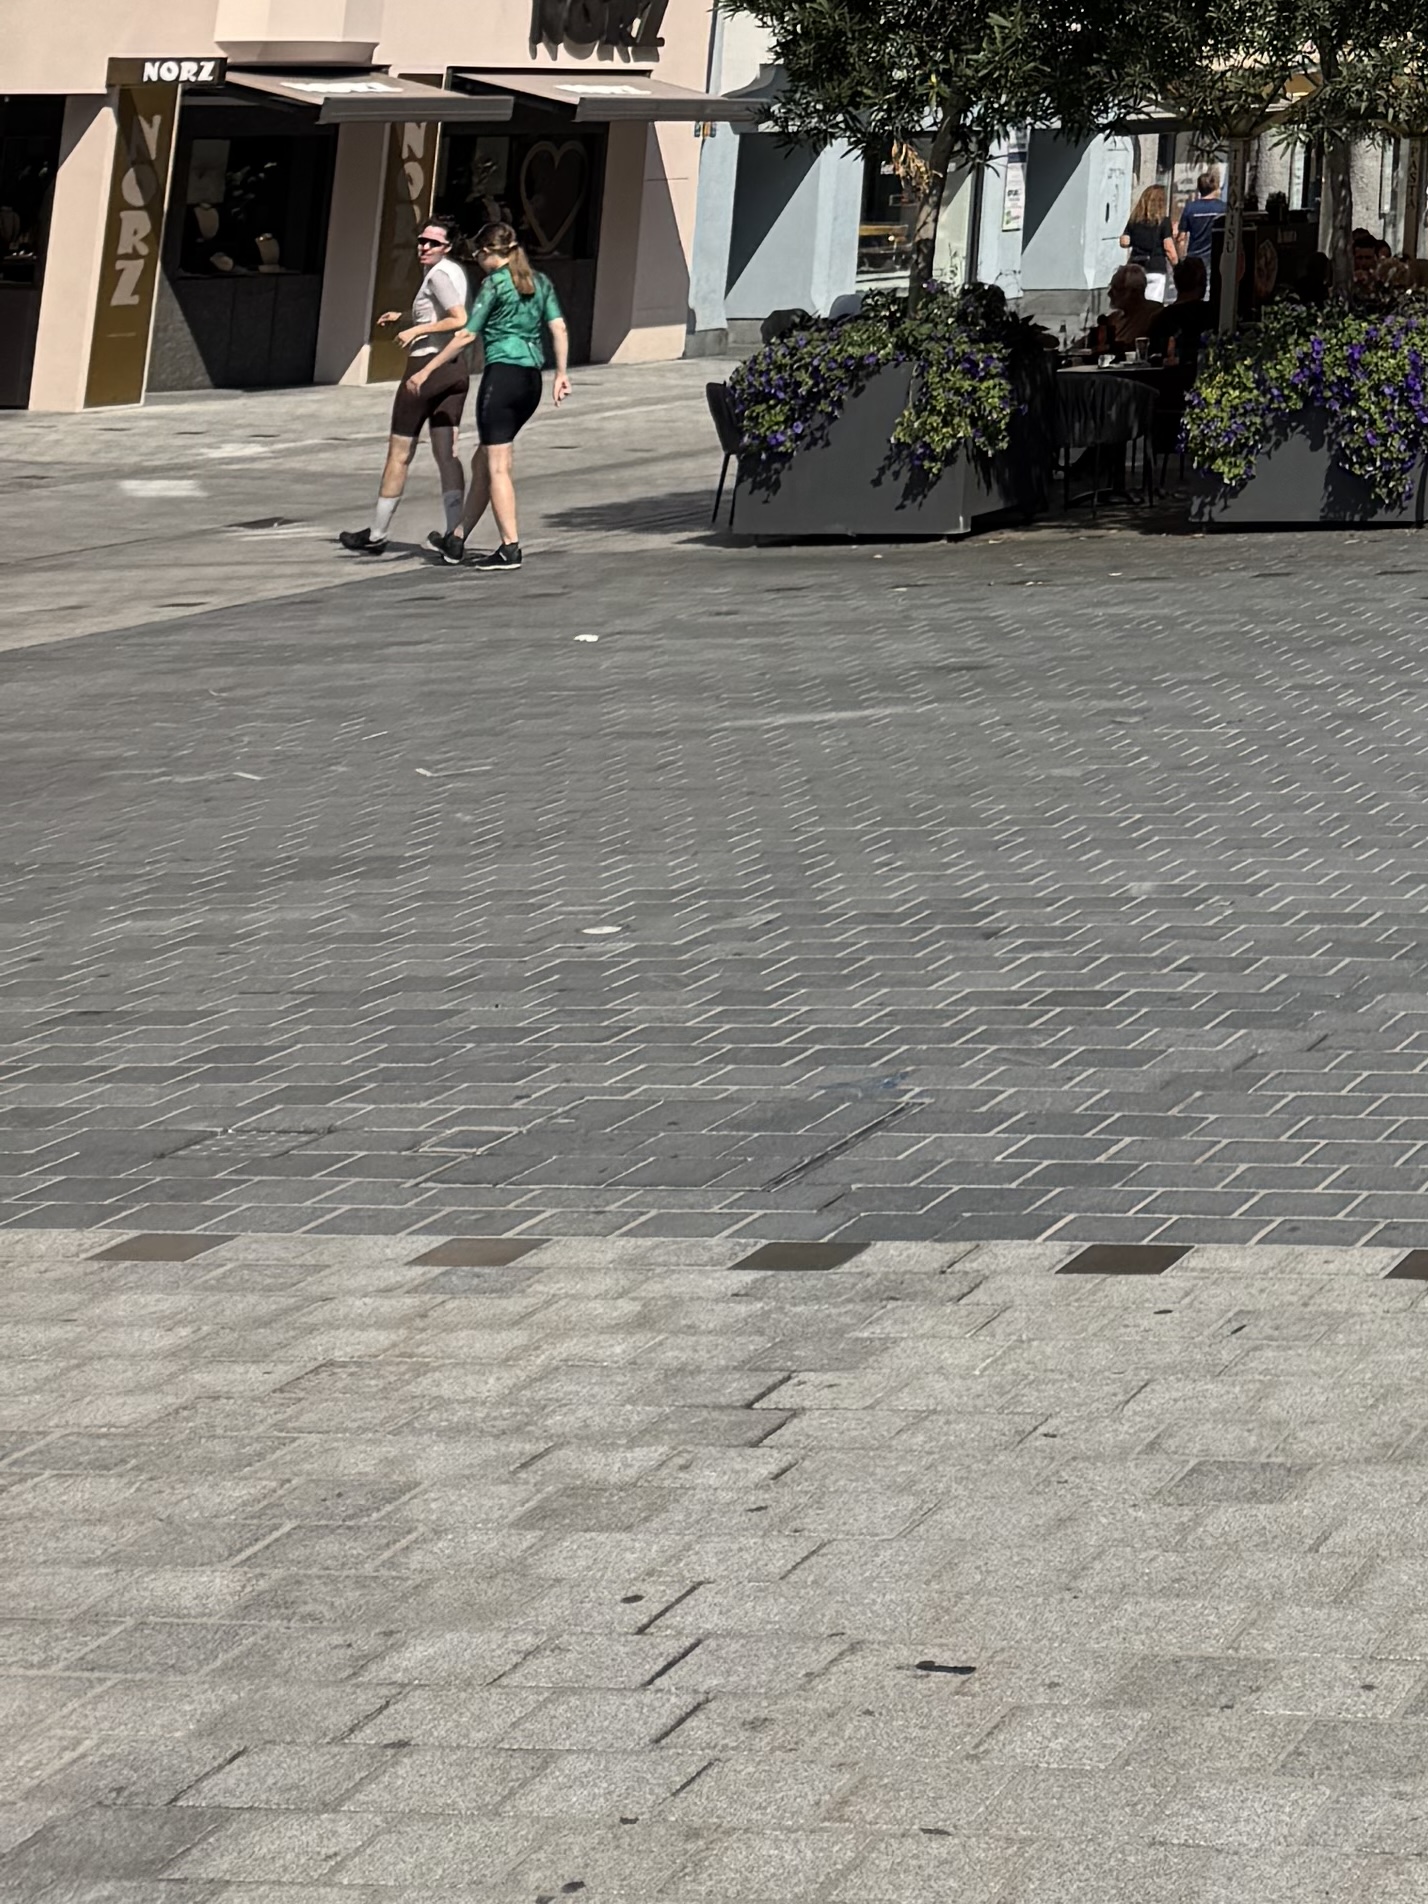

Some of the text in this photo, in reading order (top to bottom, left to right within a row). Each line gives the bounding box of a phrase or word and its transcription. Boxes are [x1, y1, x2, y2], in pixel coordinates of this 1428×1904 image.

[143, 61, 216, 83] NORZ
[1407, 146, 1419, 210] PASTA
[110, 114, 161, 307] NORZ
